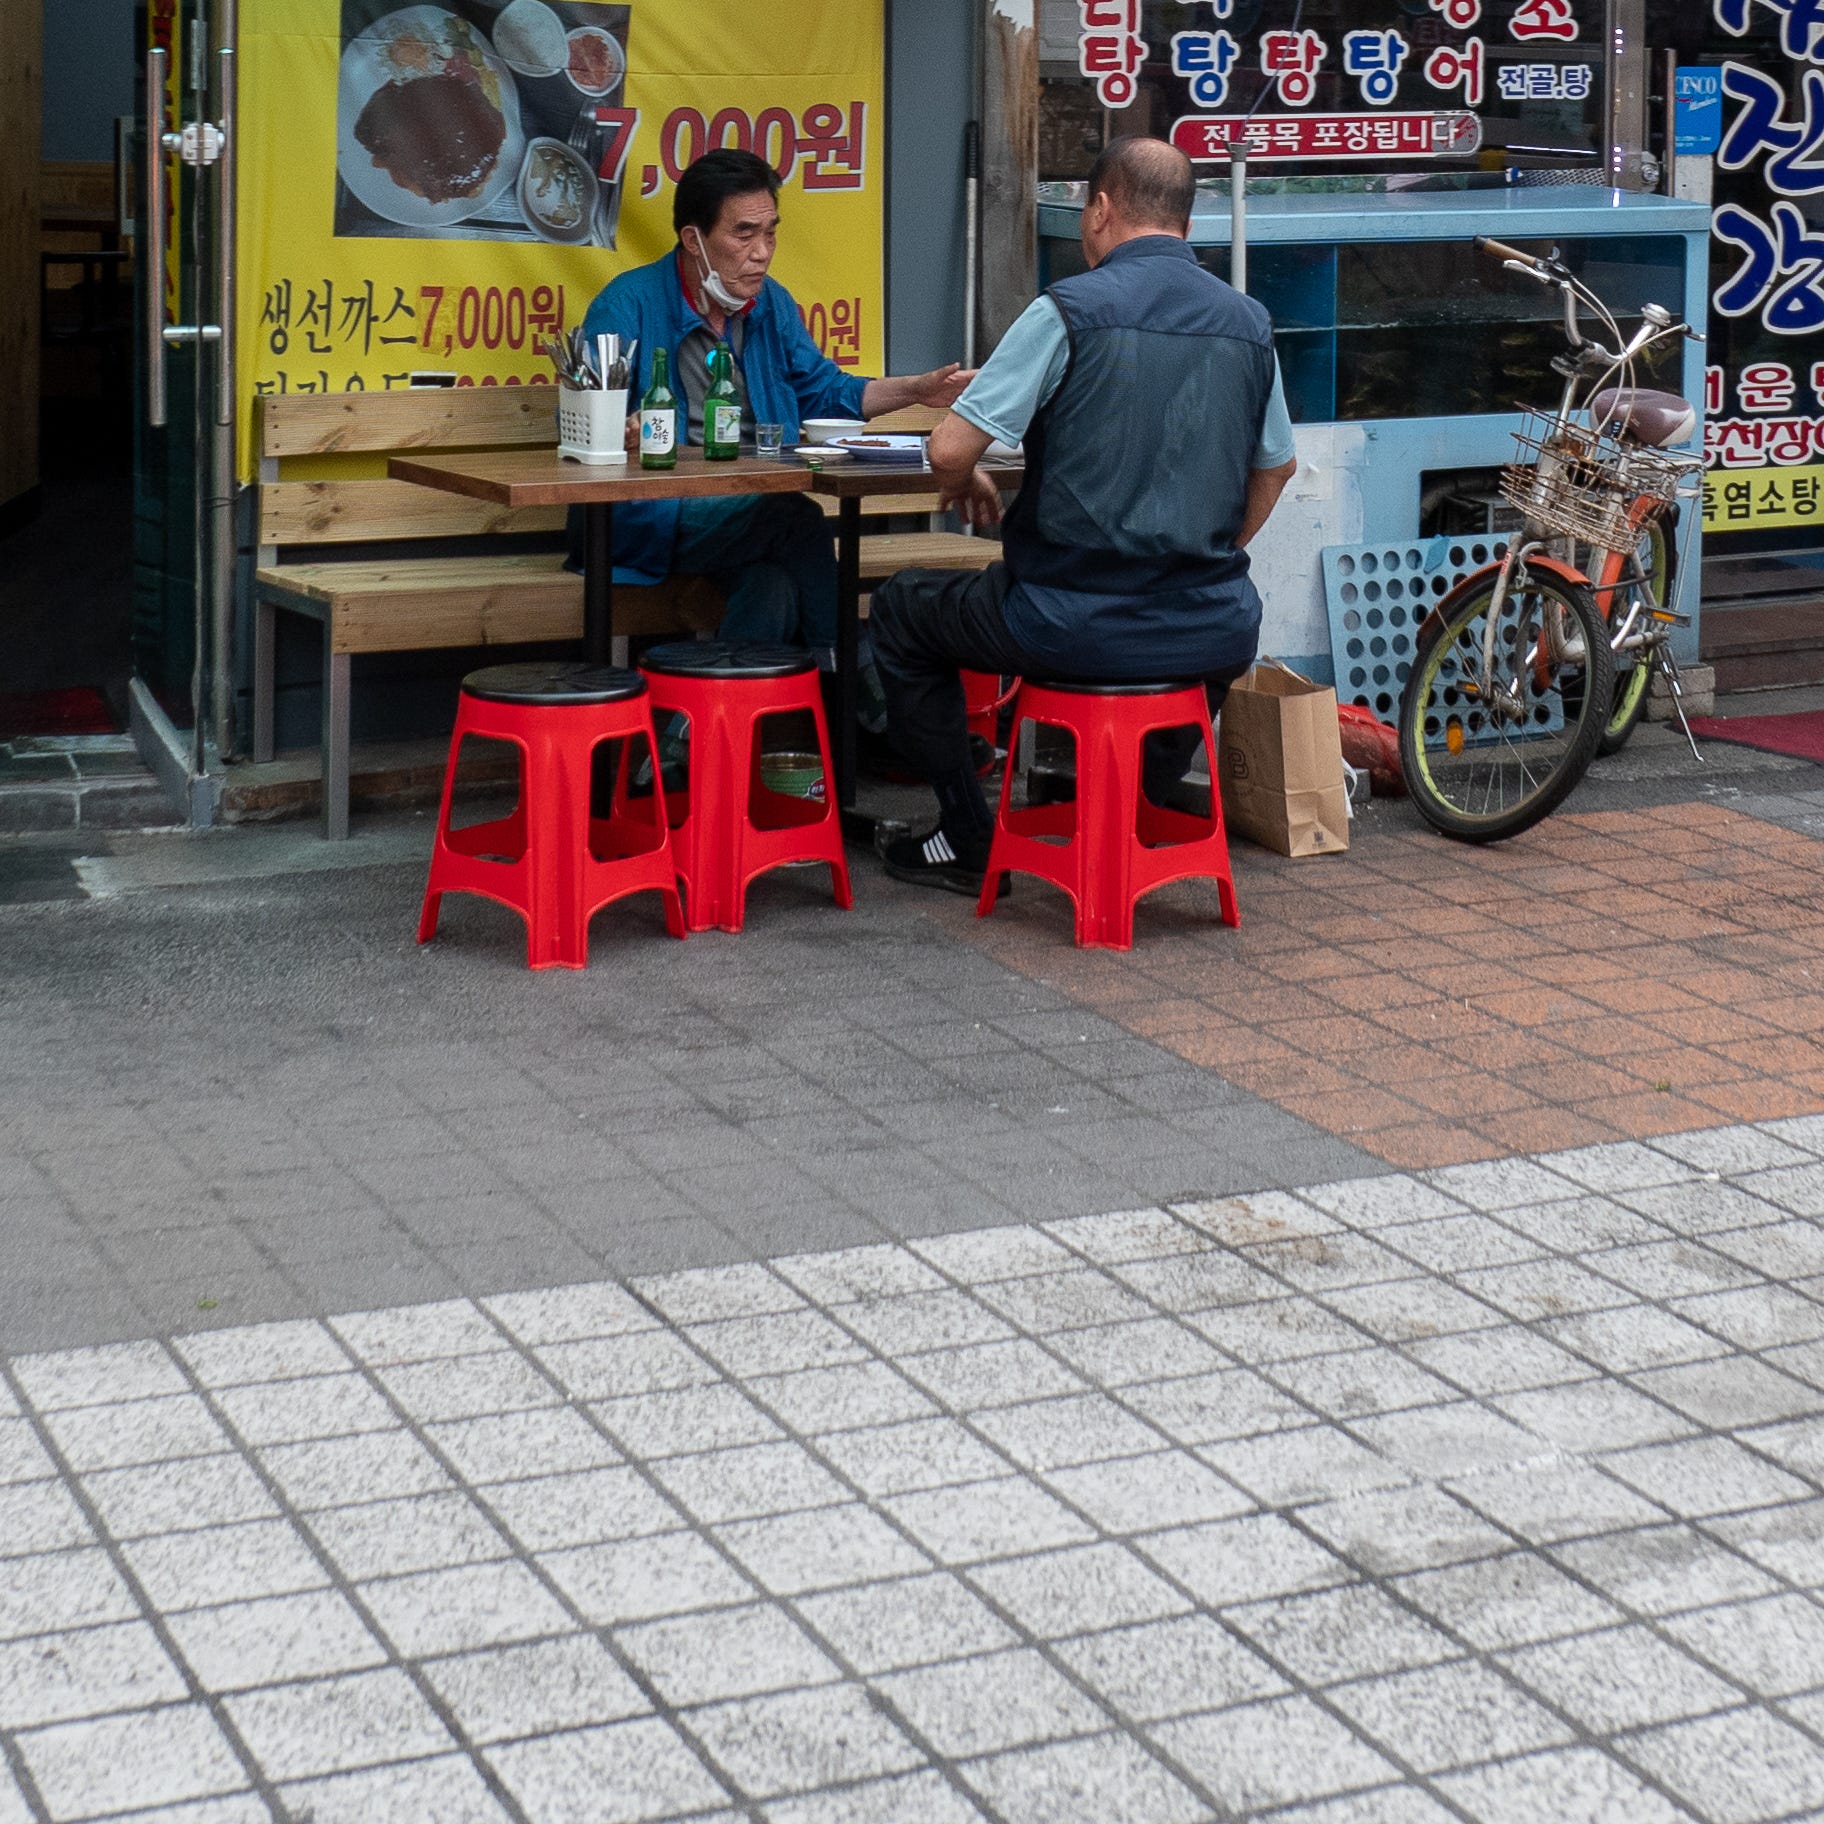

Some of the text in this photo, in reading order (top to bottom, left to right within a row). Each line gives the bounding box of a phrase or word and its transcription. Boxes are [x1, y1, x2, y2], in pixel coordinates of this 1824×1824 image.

[1203, 118, 1460, 153] 전 품목 포장됩니다
